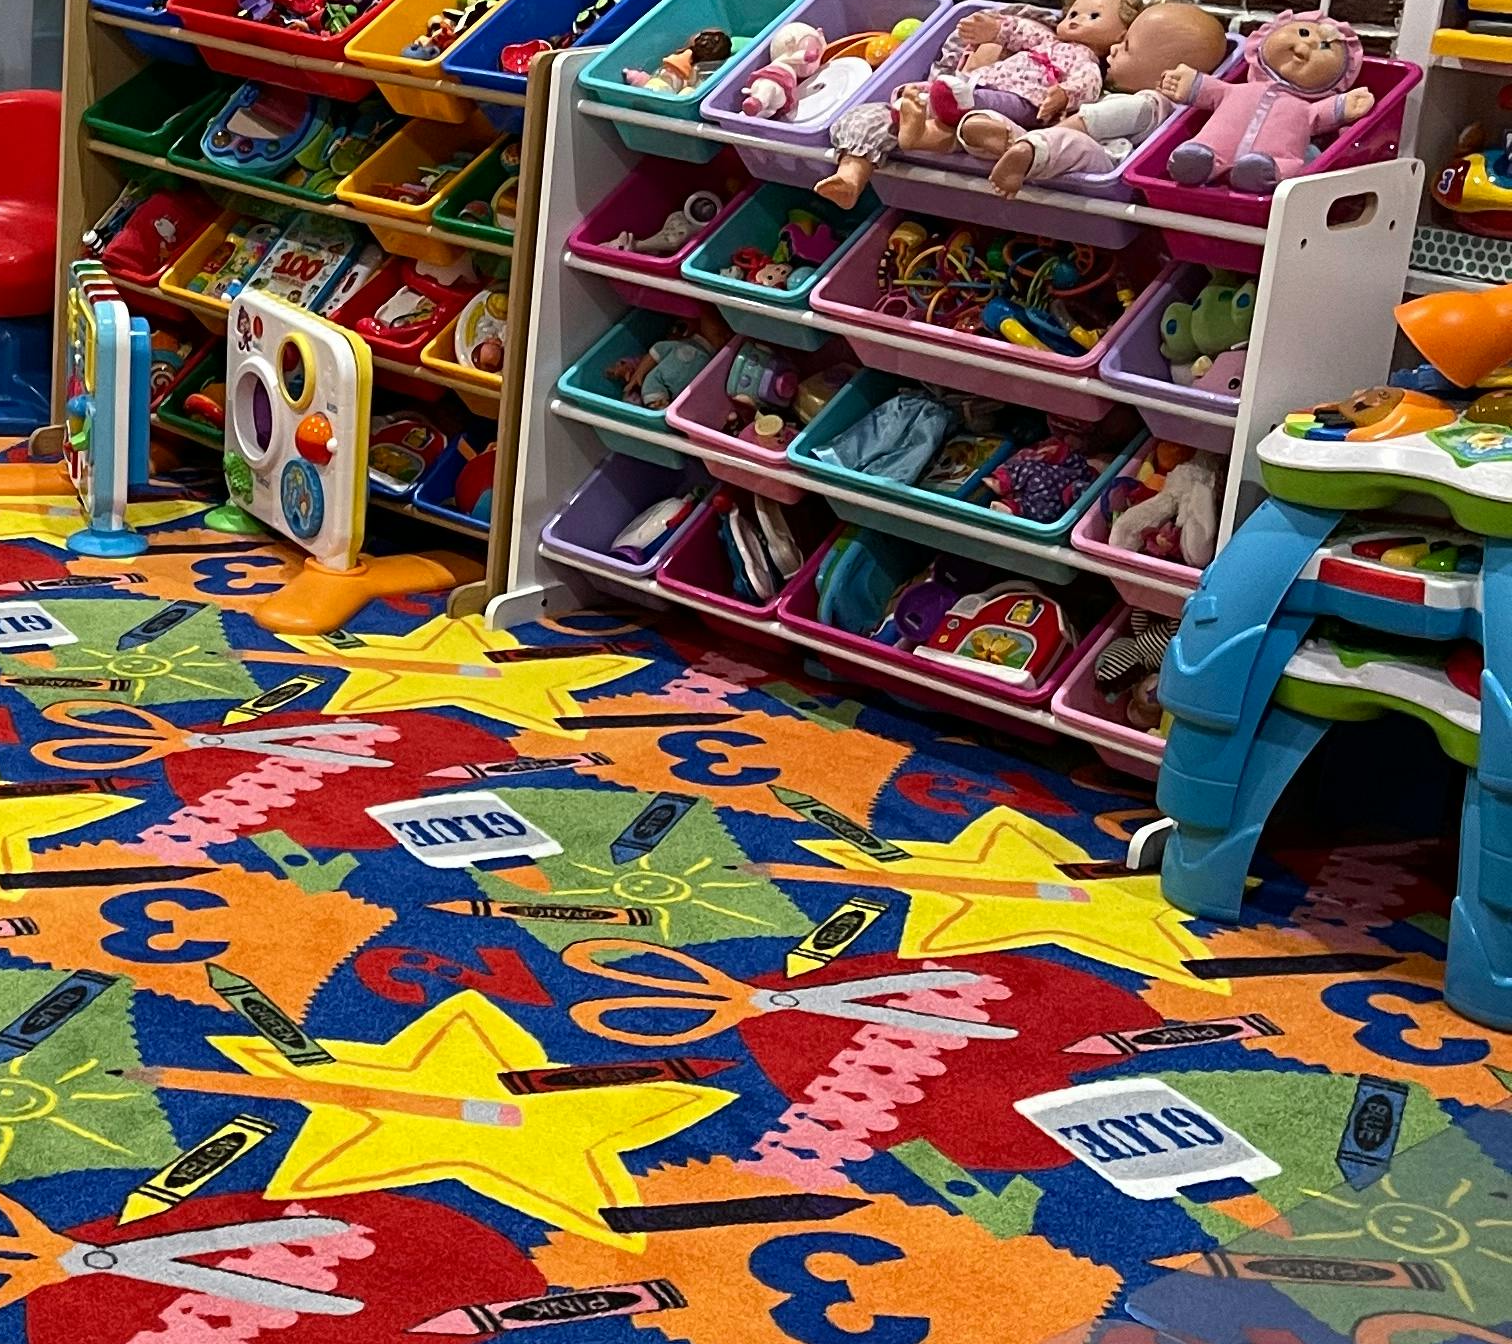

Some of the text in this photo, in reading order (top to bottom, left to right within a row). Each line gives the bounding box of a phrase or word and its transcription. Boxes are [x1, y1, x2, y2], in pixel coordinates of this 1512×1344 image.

[272, 251, 324, 281] 100
[191, 555, 284, 593] 3
[659, 731, 782, 788] 3
[391, 811, 526, 847] GLUE
[250, 831, 361, 894] 1
[99, 889, 230, 964] 3
[354, 947, 555, 1006] 2
[30, 991, 82, 1027] BLUE
[1320, 978, 1490, 1066] 3
[1058, 1108, 1224, 1161] GLUE
[1357, 1102, 1387, 1141] BLUE
[890, 1138, 1043, 1238] 1
[528, 1296, 609, 1318] PINK
